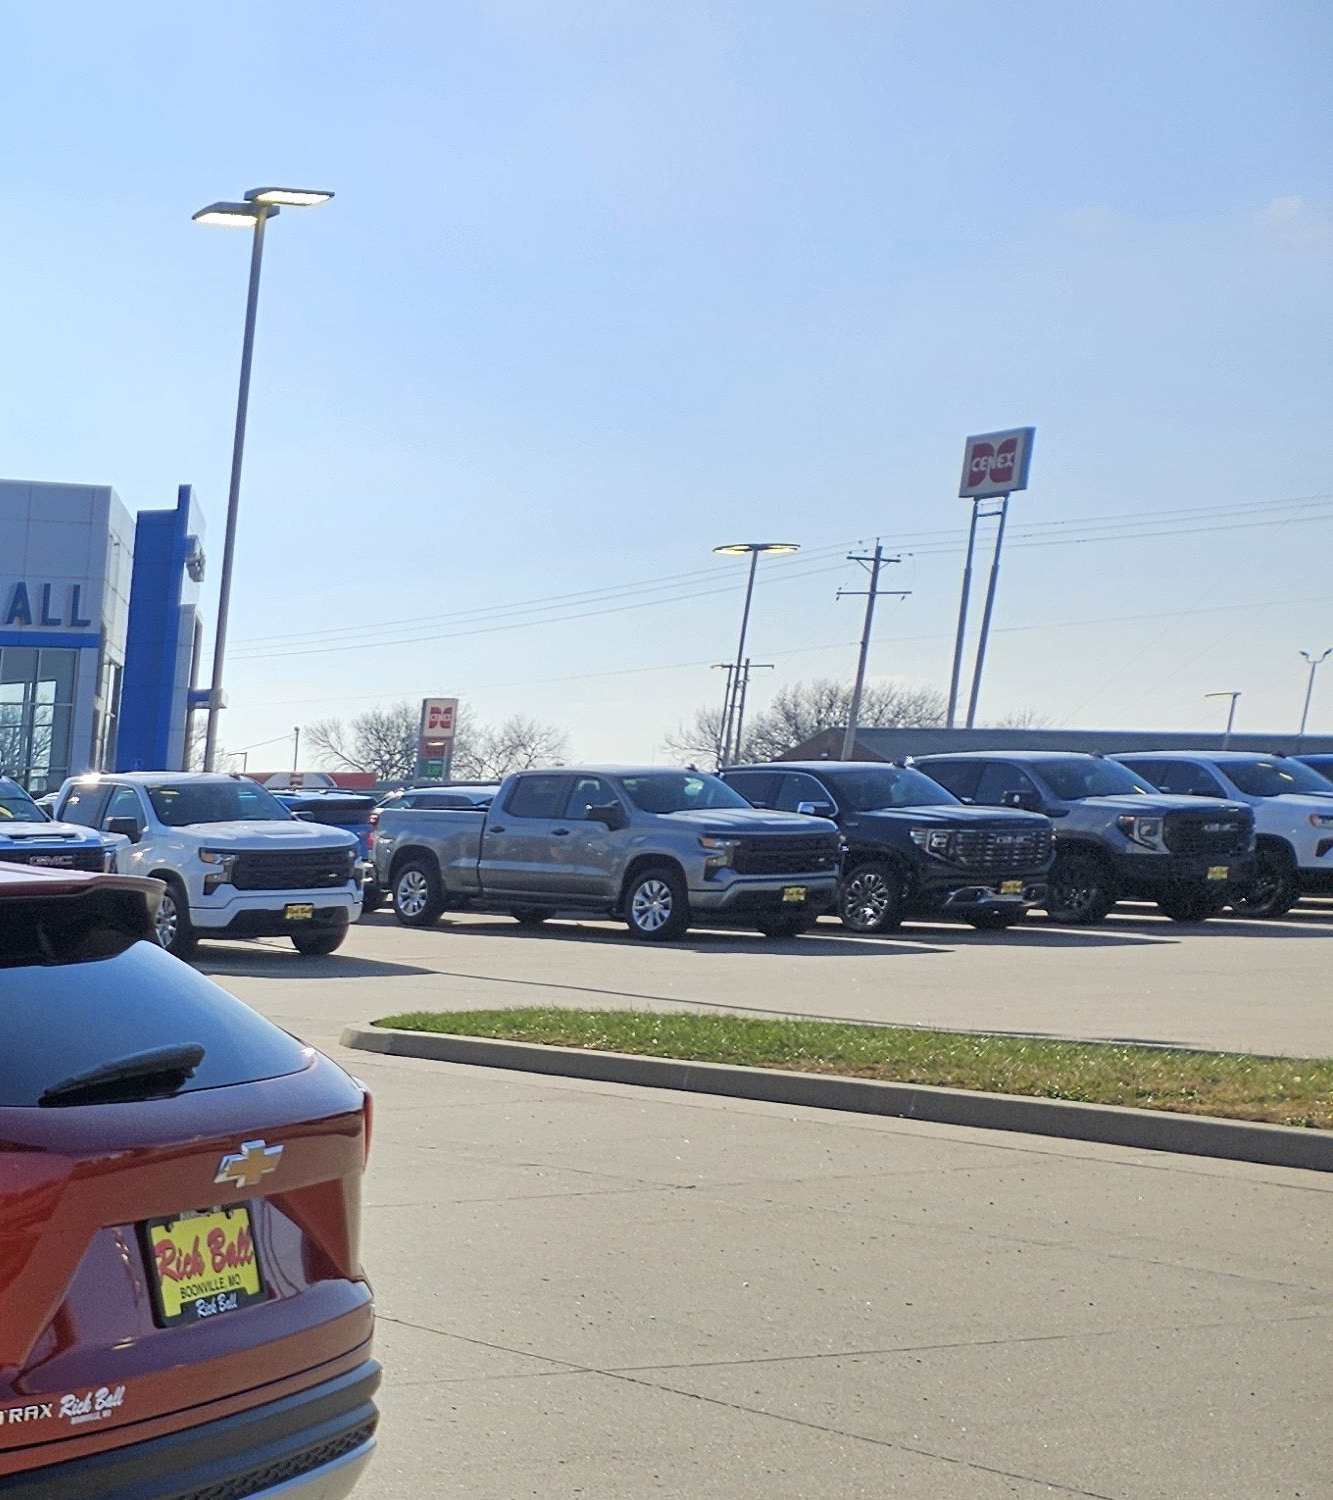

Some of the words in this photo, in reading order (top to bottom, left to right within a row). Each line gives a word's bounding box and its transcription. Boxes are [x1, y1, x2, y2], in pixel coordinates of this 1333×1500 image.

[971, 451, 1015, 472] CENEX
[155, 1234, 205, 1285] Rick
[207, 1225, 254, 1274] Ball
[228, 1273, 242, 1287] MO
[58, 1391, 93, 1419] Rick
[94, 1384, 126, 1411] Ball
